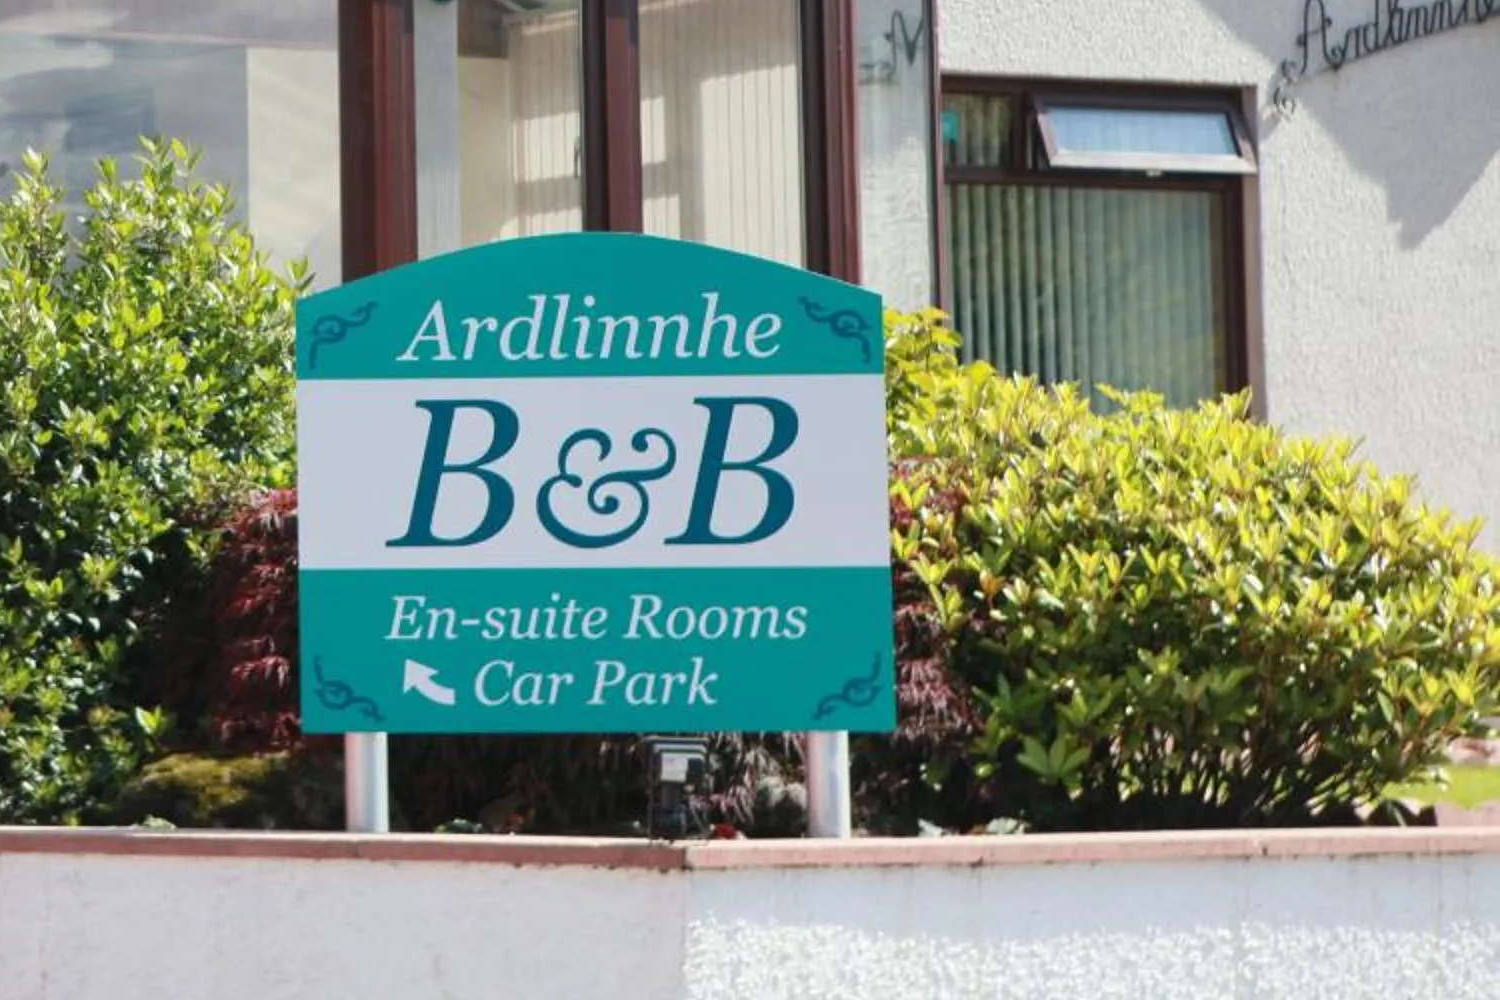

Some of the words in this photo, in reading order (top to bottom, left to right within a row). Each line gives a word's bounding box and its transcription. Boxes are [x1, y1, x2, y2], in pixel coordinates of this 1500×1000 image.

[396, 291, 783, 362] Ardlinnhe
[385, 396, 800, 549] B&B
[384, 593, 610, 641] En-suite
[622, 594, 808, 640] Rooms
[473, 659, 575, 707] Car
[586, 656, 720, 706] Park
